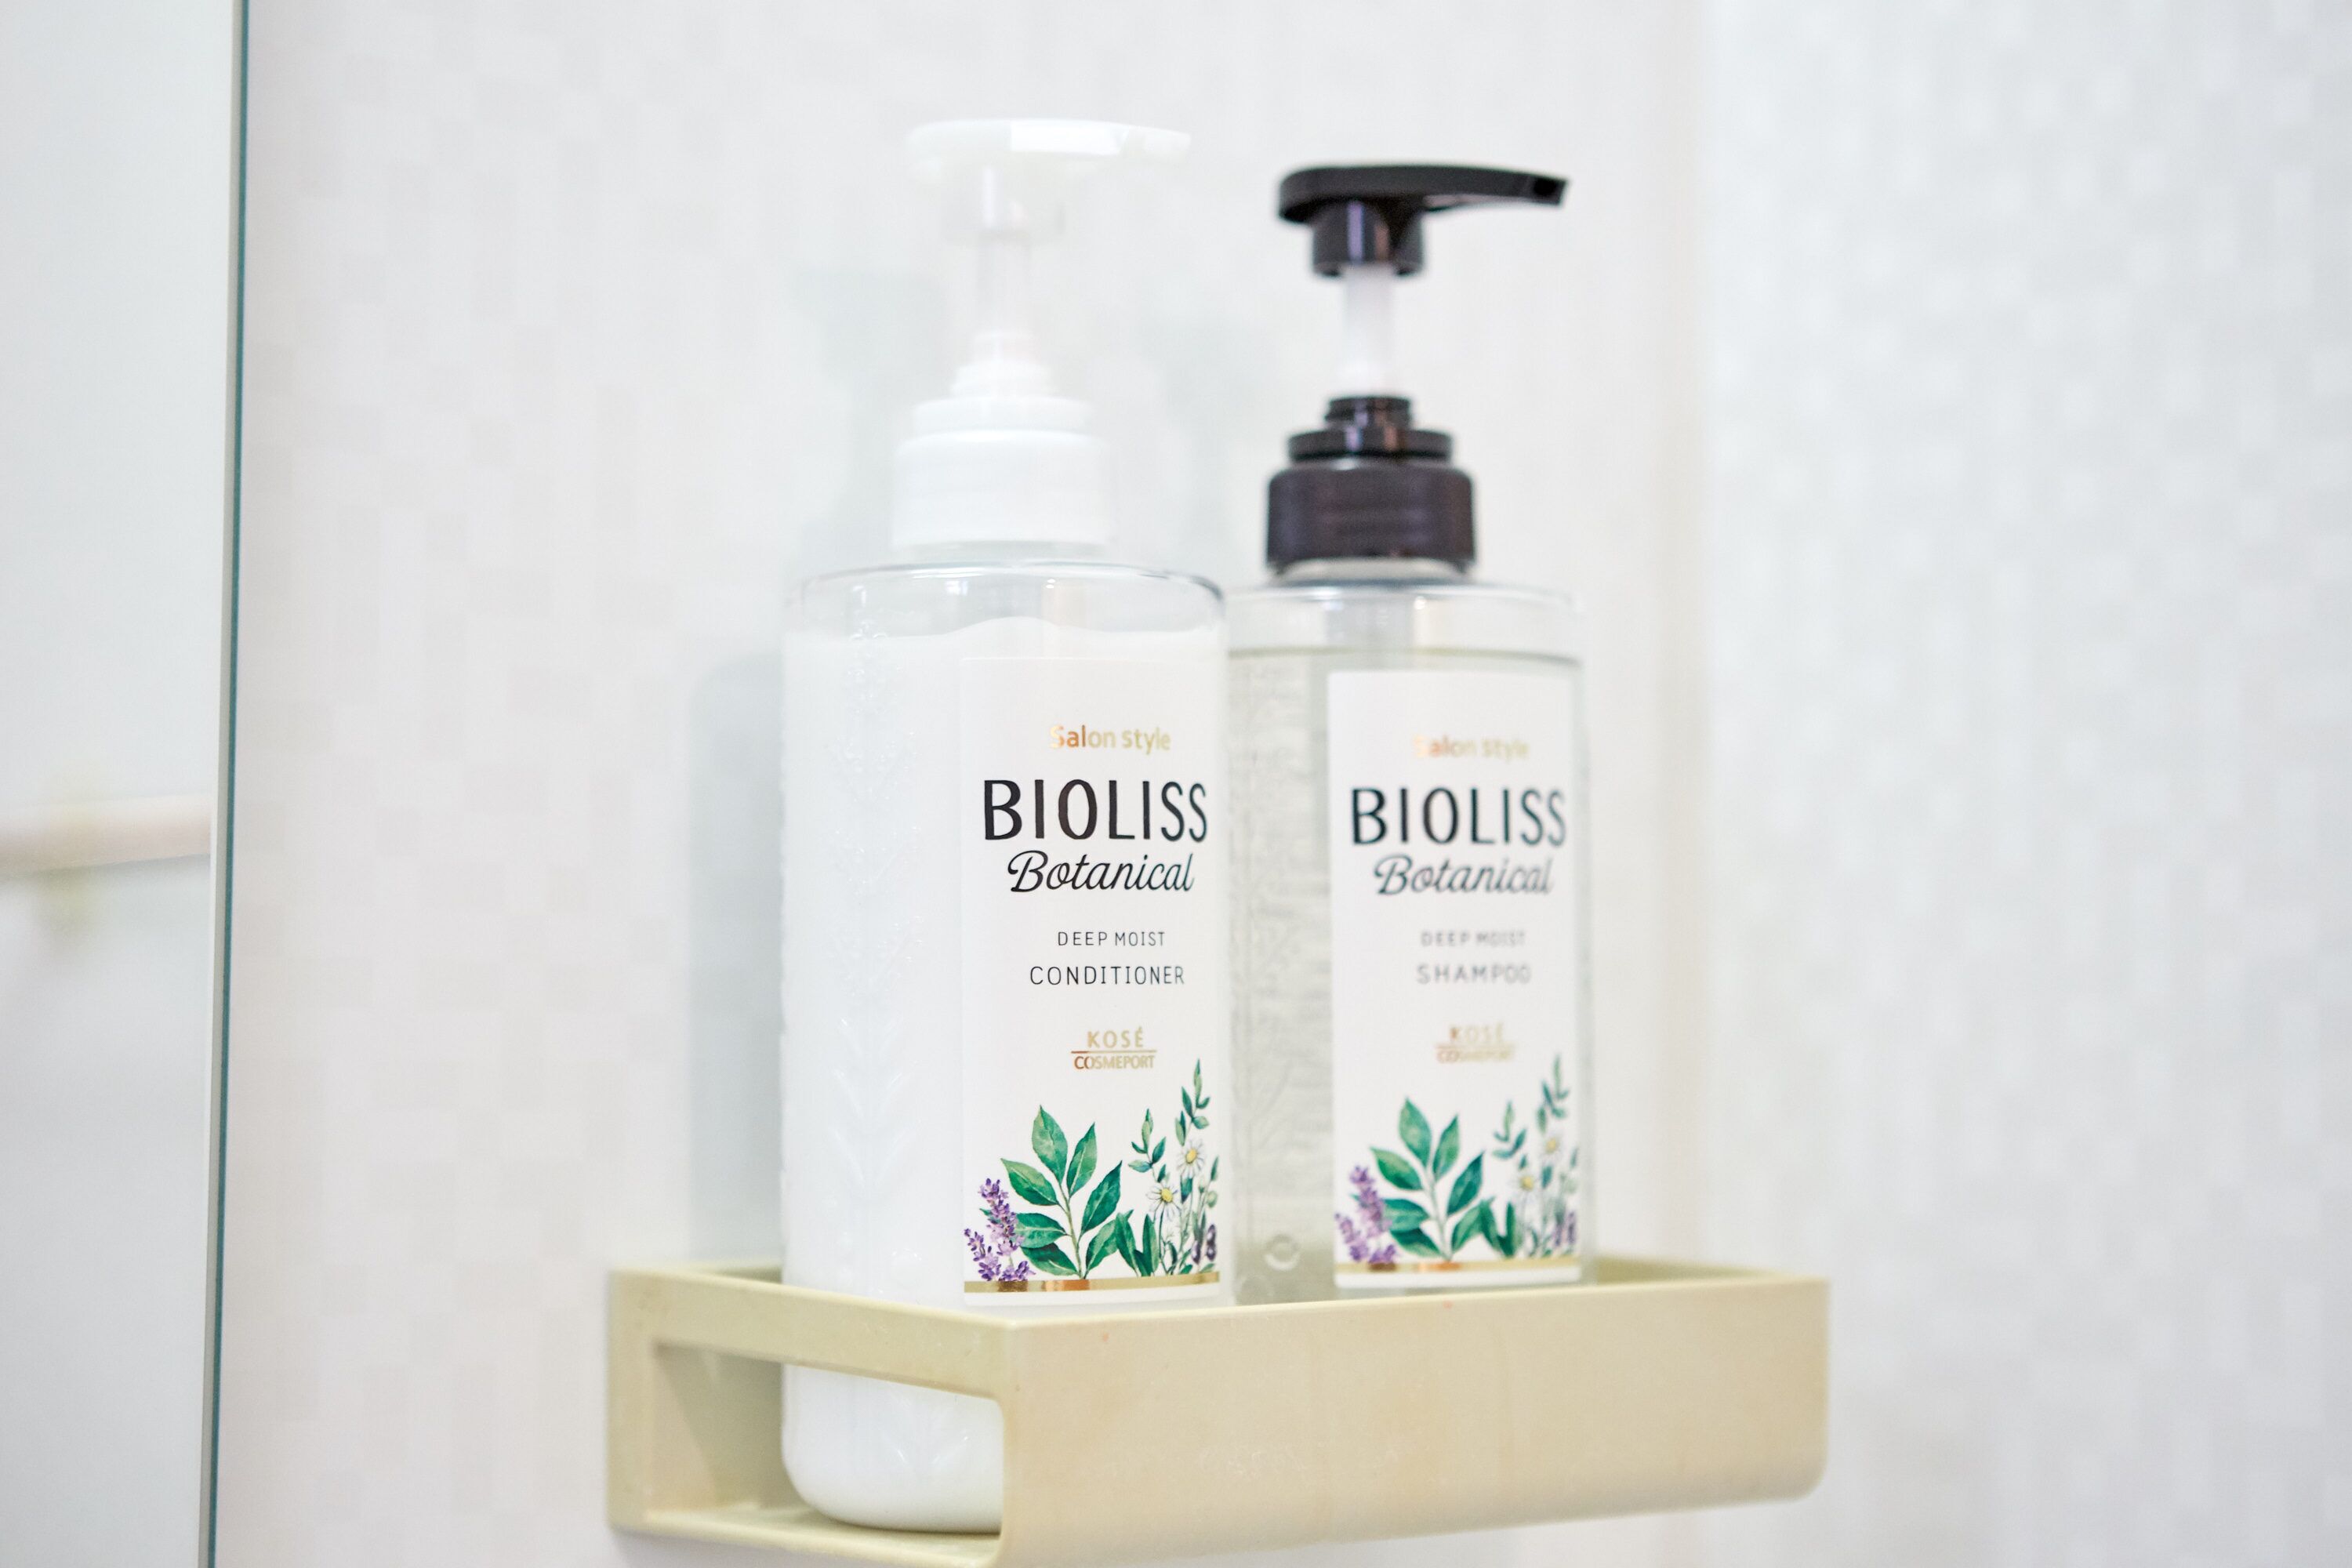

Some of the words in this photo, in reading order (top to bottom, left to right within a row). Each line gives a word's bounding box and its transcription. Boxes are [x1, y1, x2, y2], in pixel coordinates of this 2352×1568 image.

[1050, 724, 1116, 750] Salon
[1122, 726, 1171, 755] style
[1482, 736, 1529, 761] style
[983, 779, 1207, 843] BIOLISS
[1351, 787, 1567, 847] BIOLISS
[1007, 849, 1196, 892] Botanical
[1374, 853, 1555, 895] Botanical
[1058, 931, 1109, 946] DEEP
[1114, 931, 1166, 946] MOIST
[1421, 931, 1470, 947] DEEP
[1475, 931, 1526, 947] MOIST
[1029, 965, 1185, 985] CONDITIONER
[1416, 964, 1532, 985] SHAMPOO
[1087, 1026, 1145, 1049] KOSÉ
[1073, 1054, 1156, 1069] COSMEPORT
